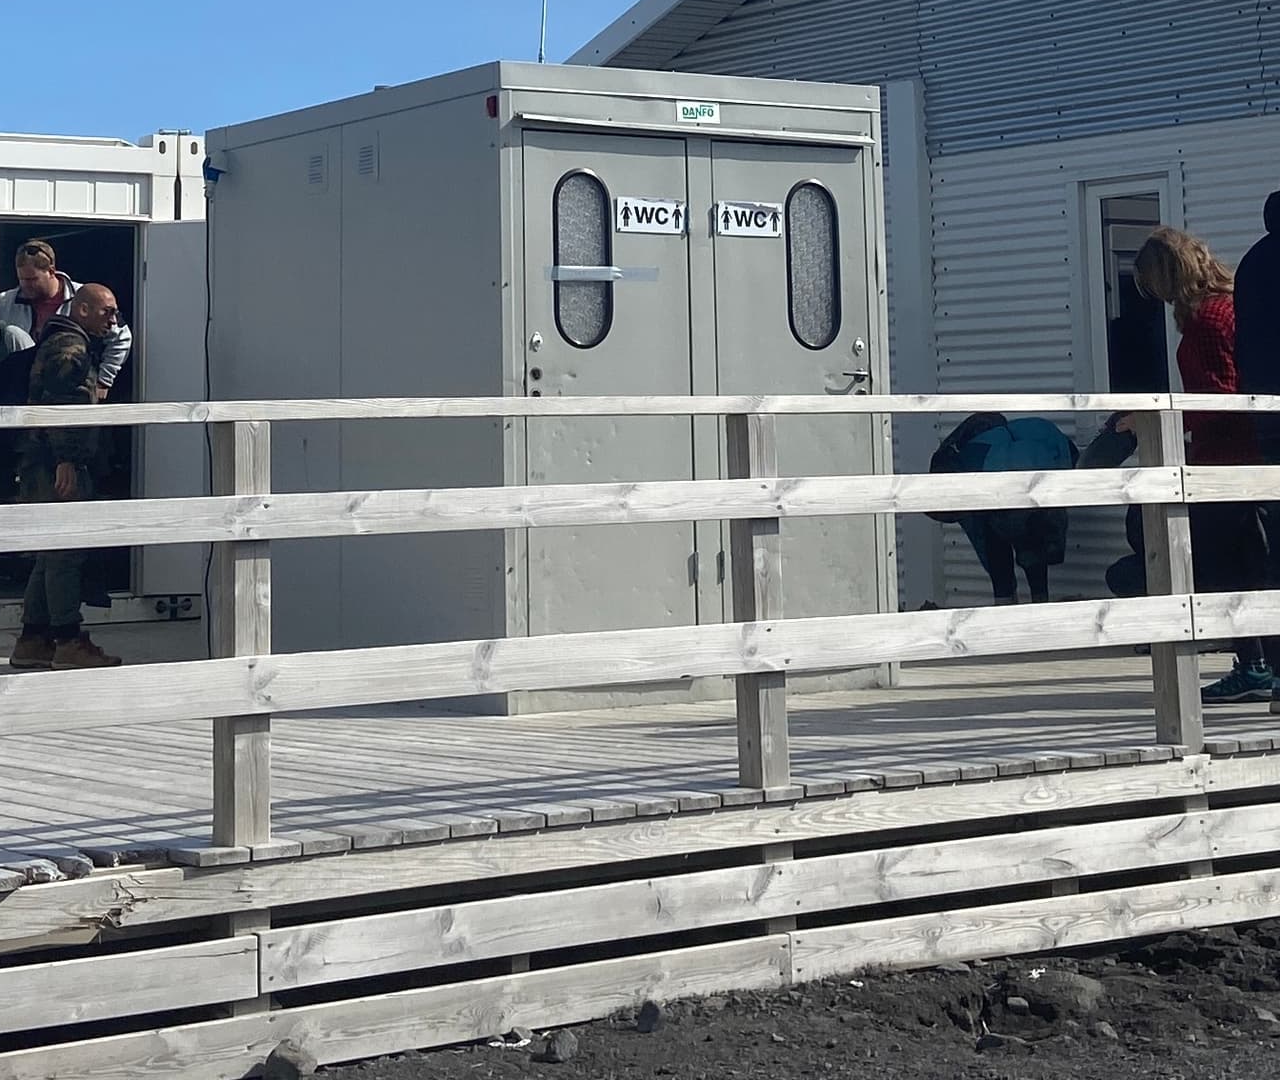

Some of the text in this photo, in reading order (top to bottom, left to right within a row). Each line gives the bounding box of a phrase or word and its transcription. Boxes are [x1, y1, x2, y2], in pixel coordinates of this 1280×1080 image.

[682, 105, 714, 119] DANFO
[633, 205, 669, 225] WC
[733, 209, 767, 229] WC
